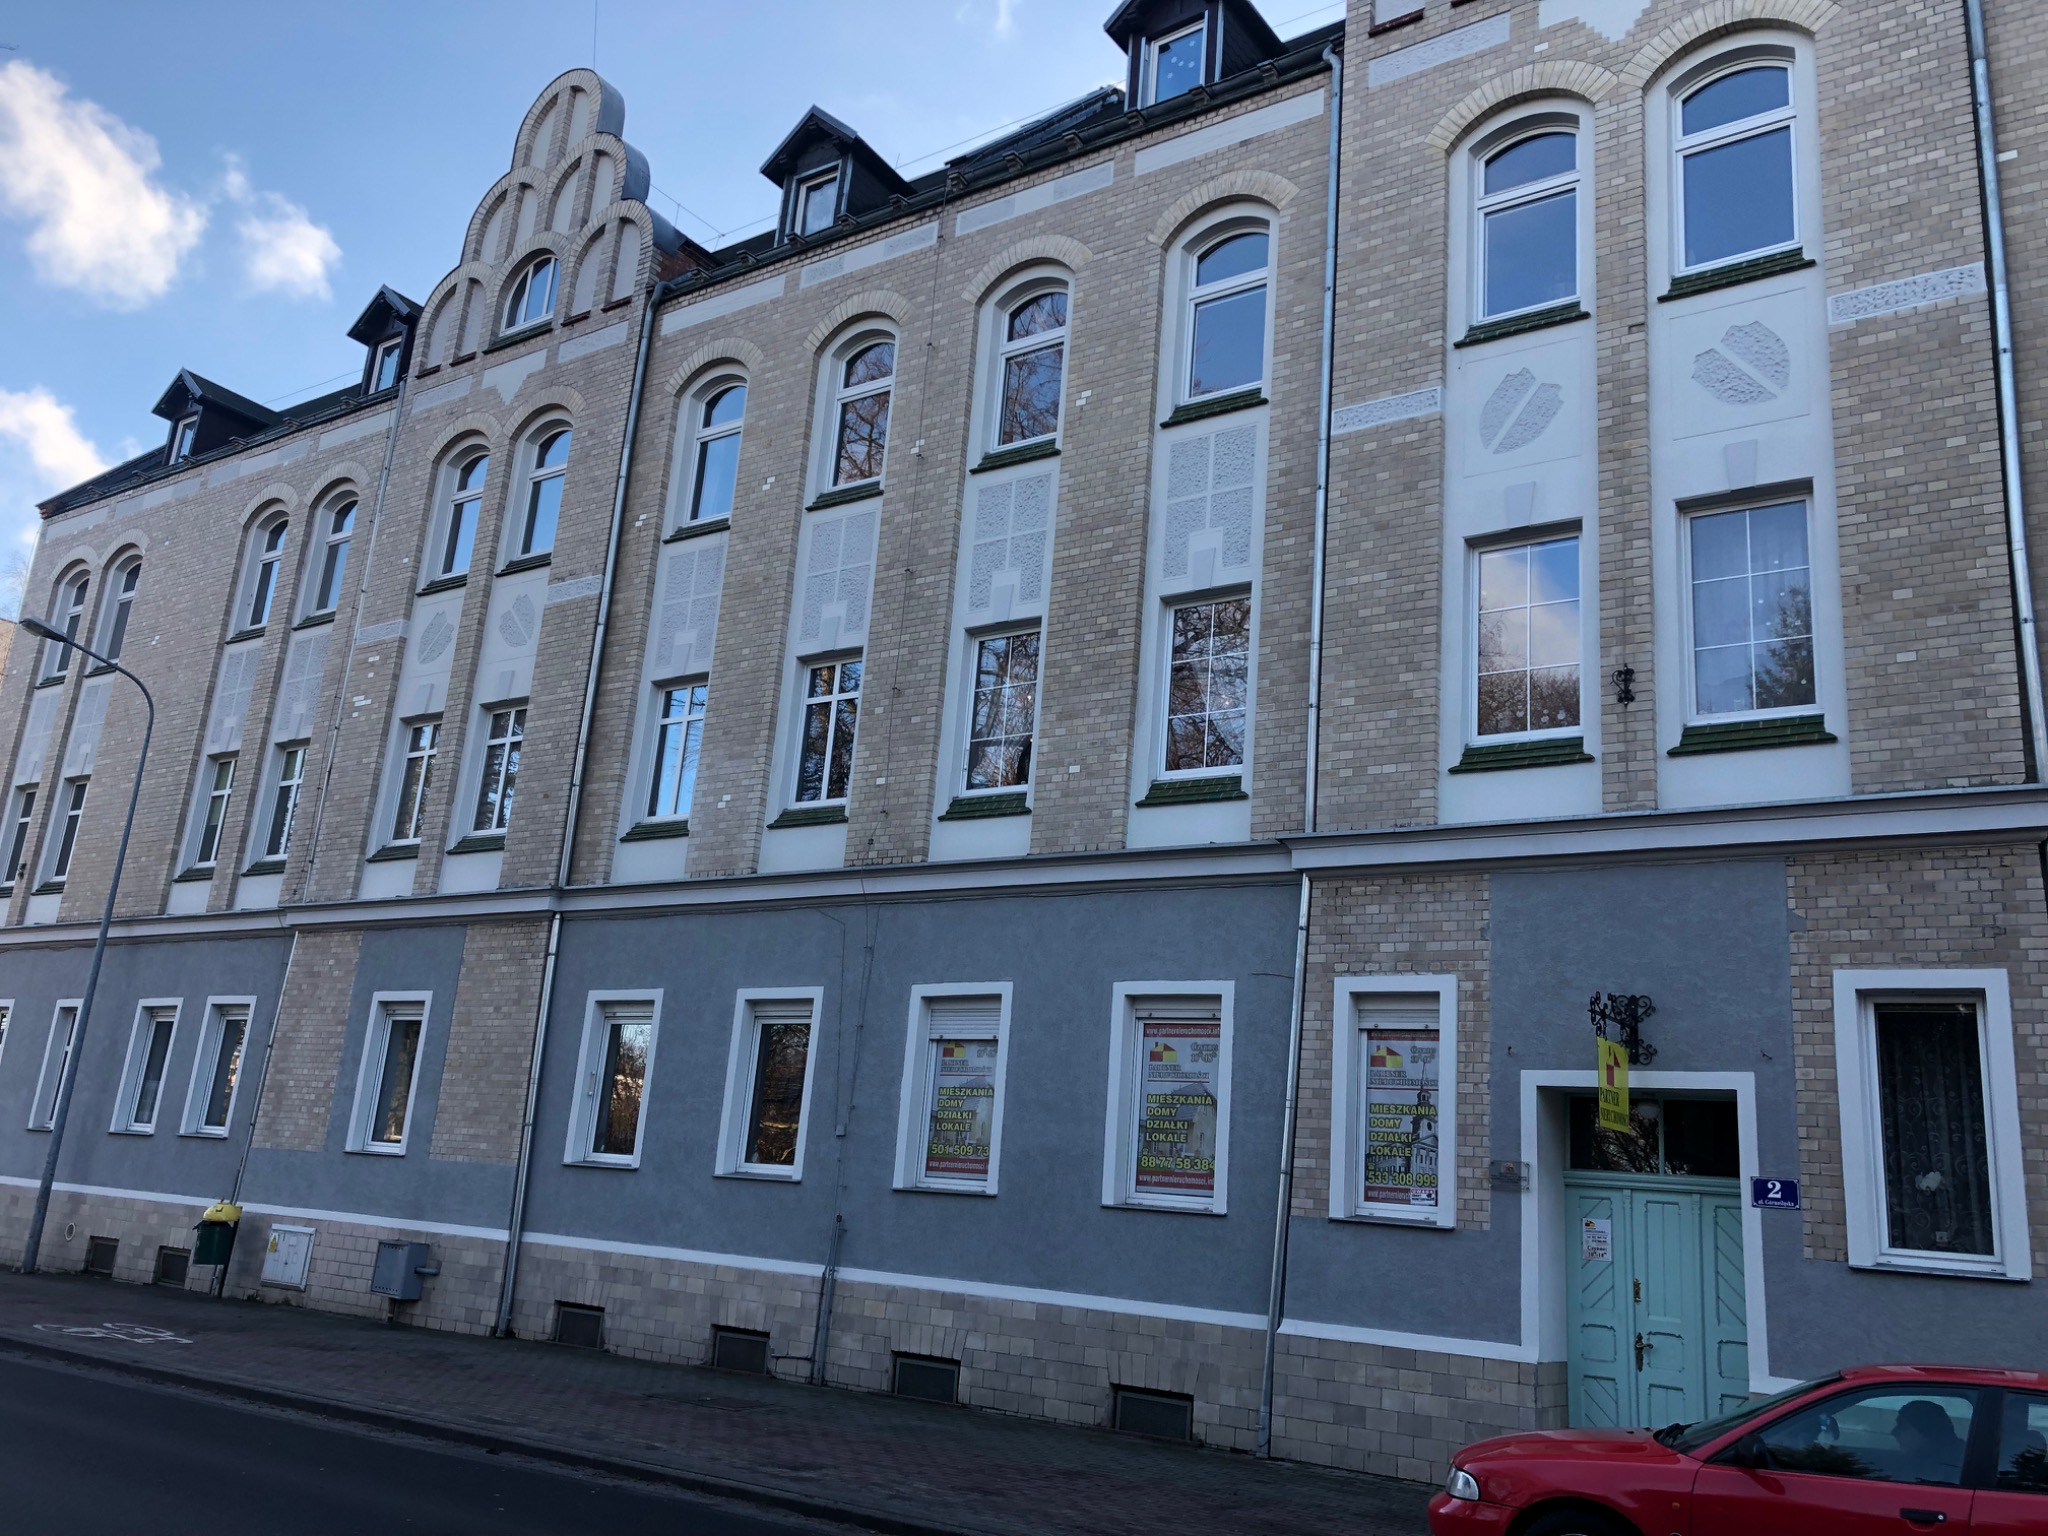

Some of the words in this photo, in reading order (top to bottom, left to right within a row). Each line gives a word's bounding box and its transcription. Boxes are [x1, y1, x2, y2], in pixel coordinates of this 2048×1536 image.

[939, 1087, 994, 1096] MIESZKANIA
[938, 1099, 964, 1107] DOMY
[1147, 1094, 1213, 1105] MIESZKANIA
[937, 1110, 972, 1119] DZIAŁKI
[1147, 1107, 1177, 1116] DOMY
[1370, 1103, 1437, 1116] MIESZKANIA
[936, 1122, 971, 1131] LOKALE
[1146, 1120, 1188, 1129] DZIAŁKI
[1370, 1117, 1401, 1128] DOMY
[1146, 1132, 1187, 1142] LOKALE
[1370, 1131, 1412, 1143] DZIAŁKI
[931, 1144, 950, 1154] 501
[953, 1145, 973, 1156] 509
[1370, 1146, 1412, 1157] LOKALE
[1367, 1171, 1389, 1184] 533
[1392, 1172, 1413, 1186] 308
[1416, 1174, 1437, 1187] 999
[1767, 1181, 1781, 1198] 2
